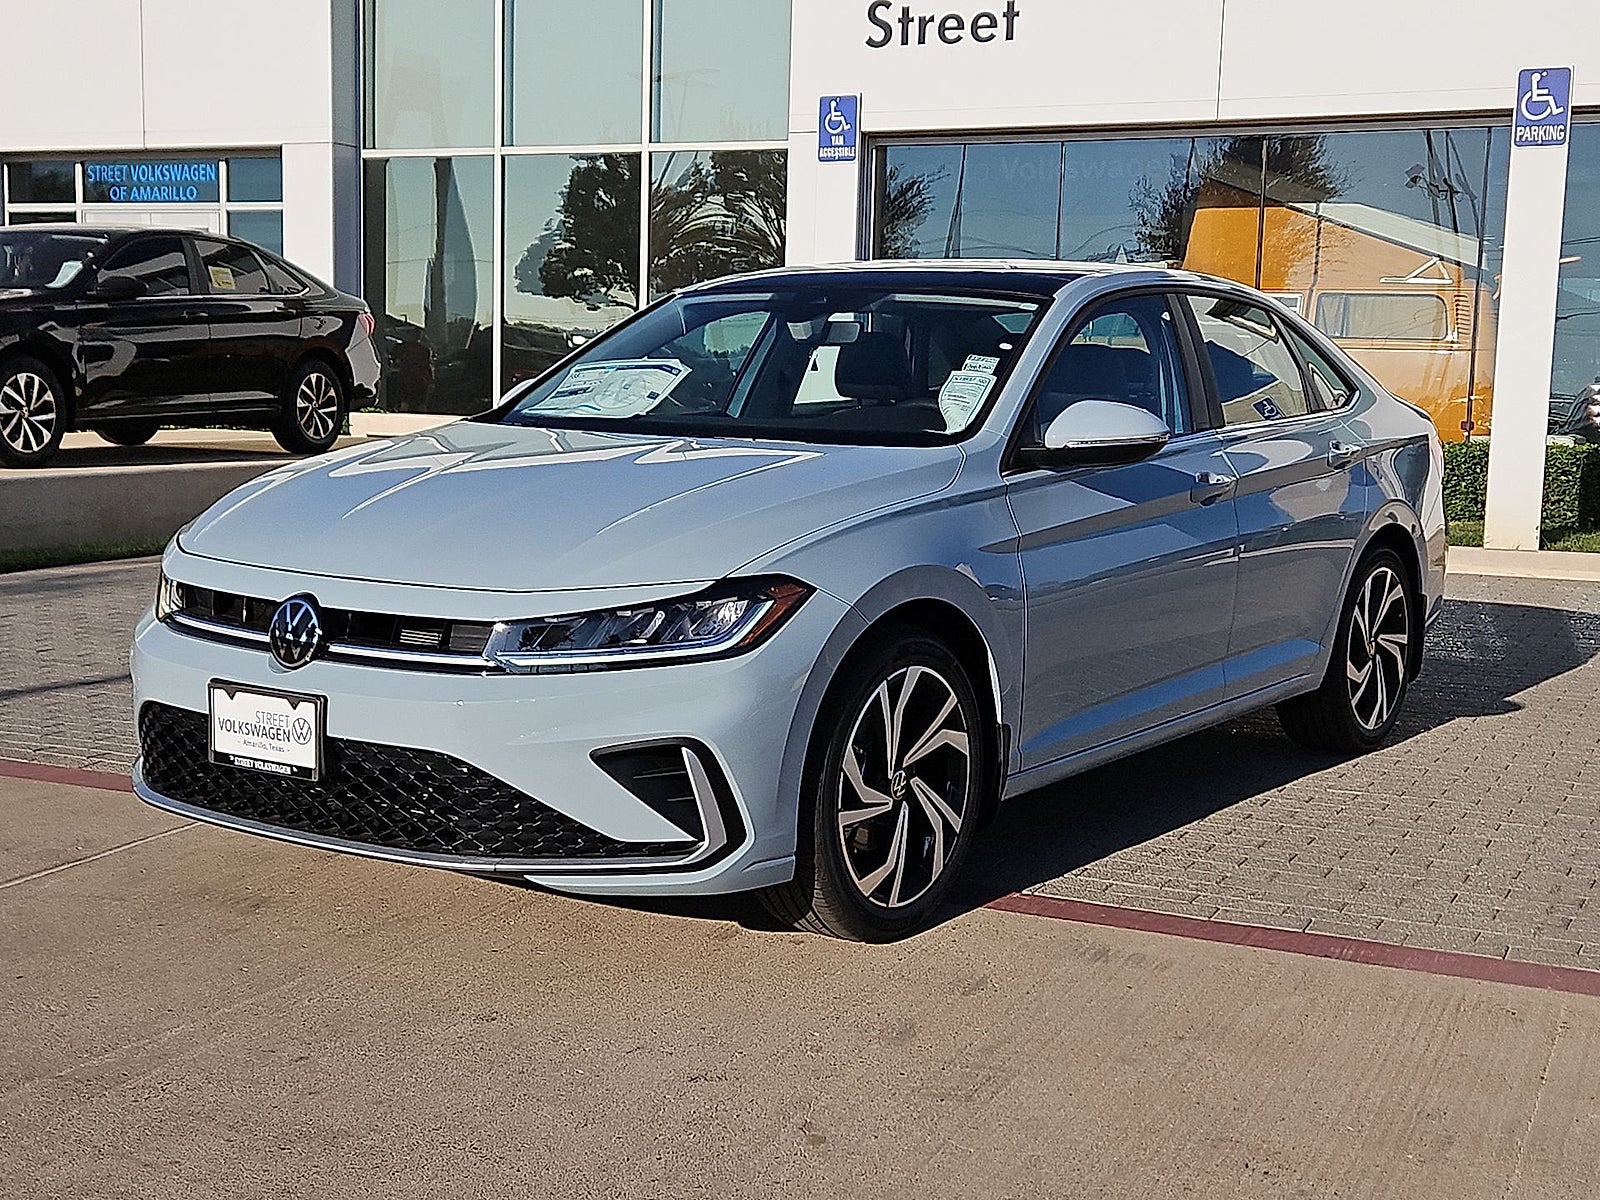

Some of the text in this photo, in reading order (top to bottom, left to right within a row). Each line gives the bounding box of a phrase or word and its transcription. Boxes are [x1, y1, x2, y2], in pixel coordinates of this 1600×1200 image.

[865, 0, 1020, 48] Street
[831, 135, 844, 146] VAN
[1515, 124, 1565, 142] PARKING
[819, 146, 856, 158] ACCESSIBLE
[87, 163, 216, 182] STREET VOLKSWAGEN
[109, 185, 197, 200] OF AMARILLO
[255, 710, 291, 728] STREET
[217, 716, 291, 742] VOLKSWAGEN
